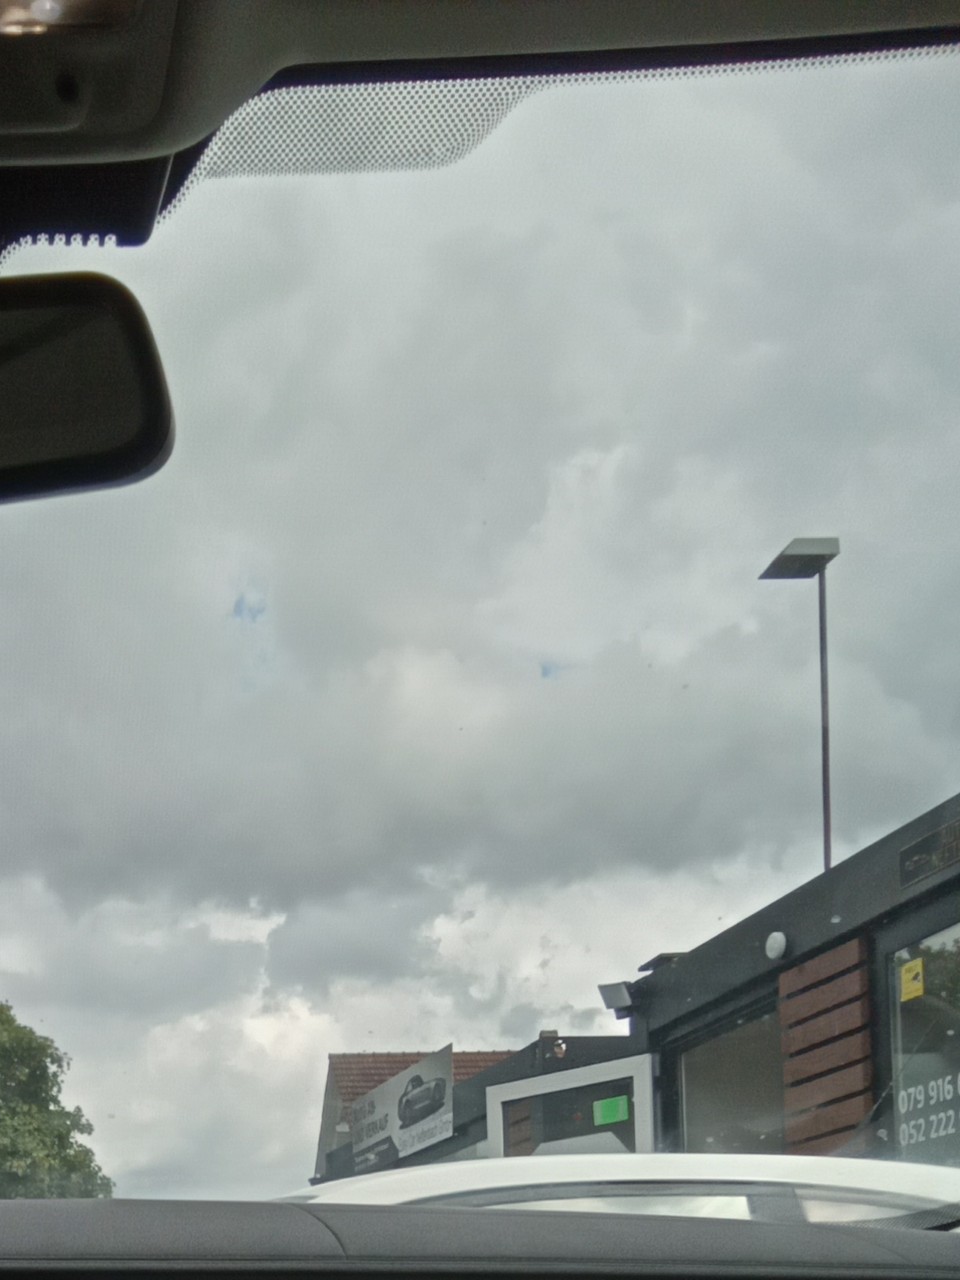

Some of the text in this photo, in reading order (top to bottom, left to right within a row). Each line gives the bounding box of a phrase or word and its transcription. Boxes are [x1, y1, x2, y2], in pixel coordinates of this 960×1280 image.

[898, 1085, 925, 1114] 079
[928, 1075, 954, 1105] 916
[899, 1109, 956, 1147] 052 222
